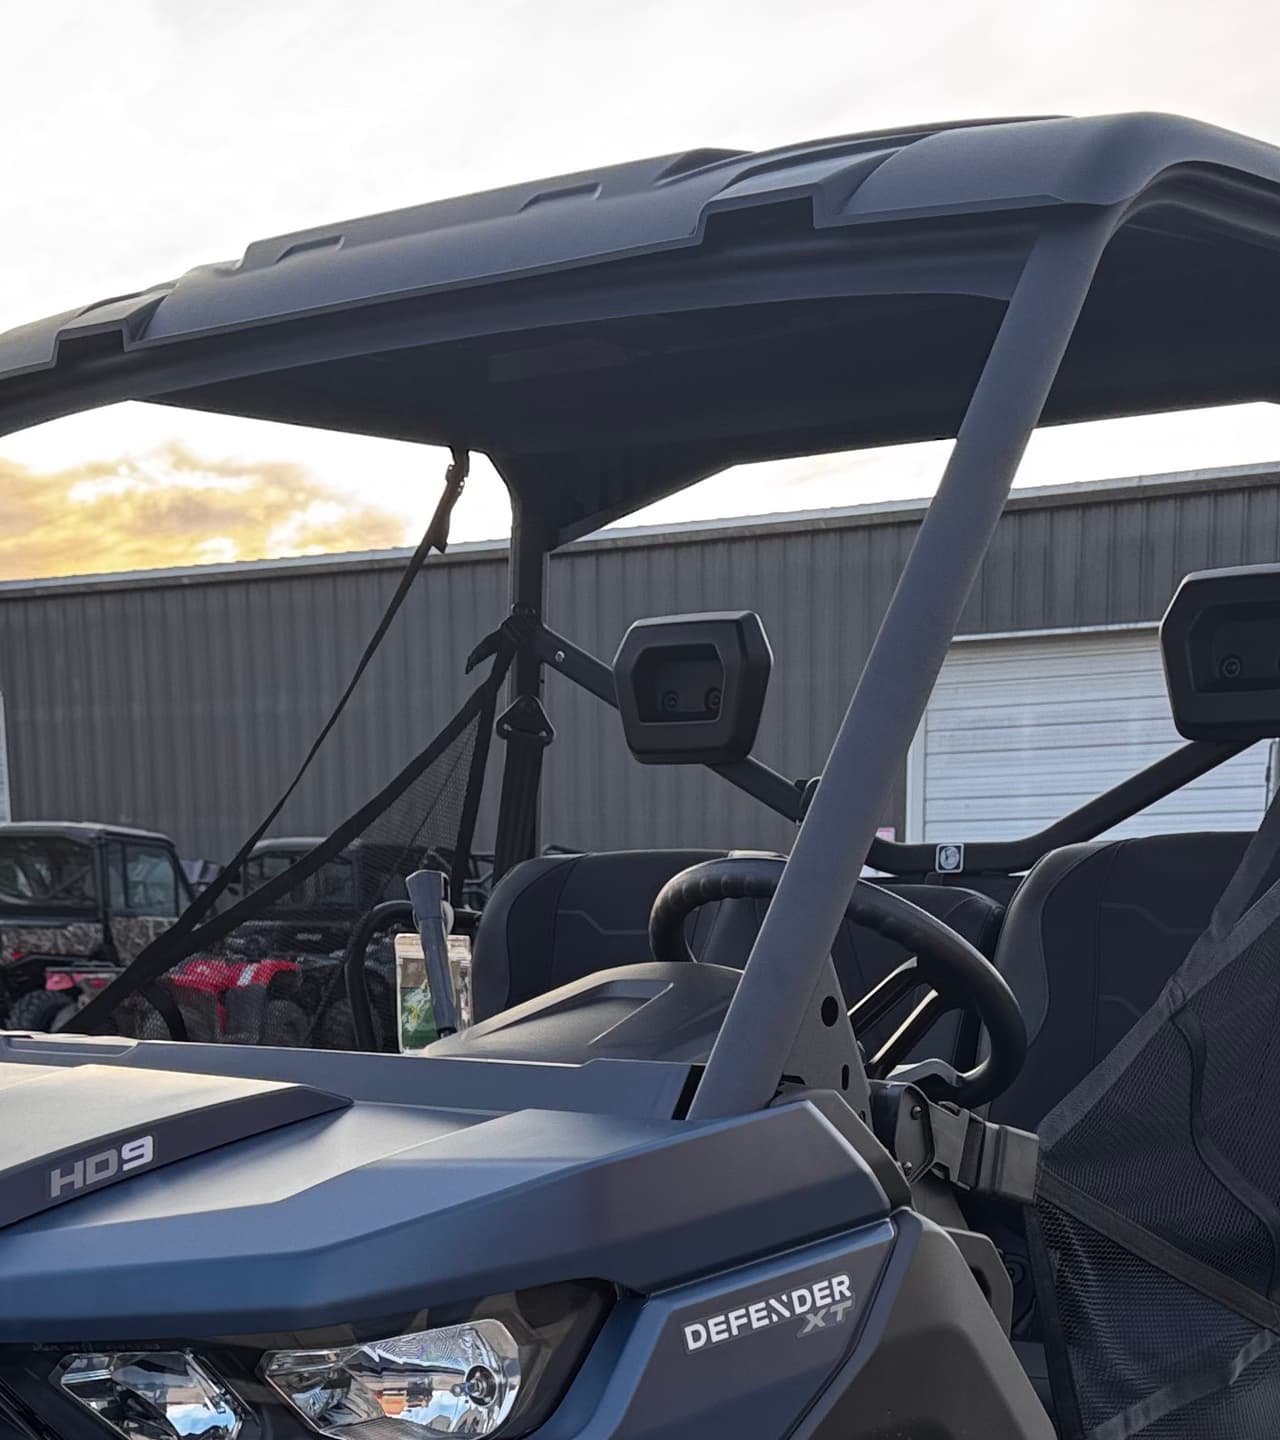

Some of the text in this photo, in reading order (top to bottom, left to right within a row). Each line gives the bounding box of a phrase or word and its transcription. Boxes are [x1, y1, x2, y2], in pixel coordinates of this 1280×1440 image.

[50, 1135, 154, 1199] HD9
[684, 1274, 852, 1351] DEFENDER
[801, 1299, 853, 1334] XT
